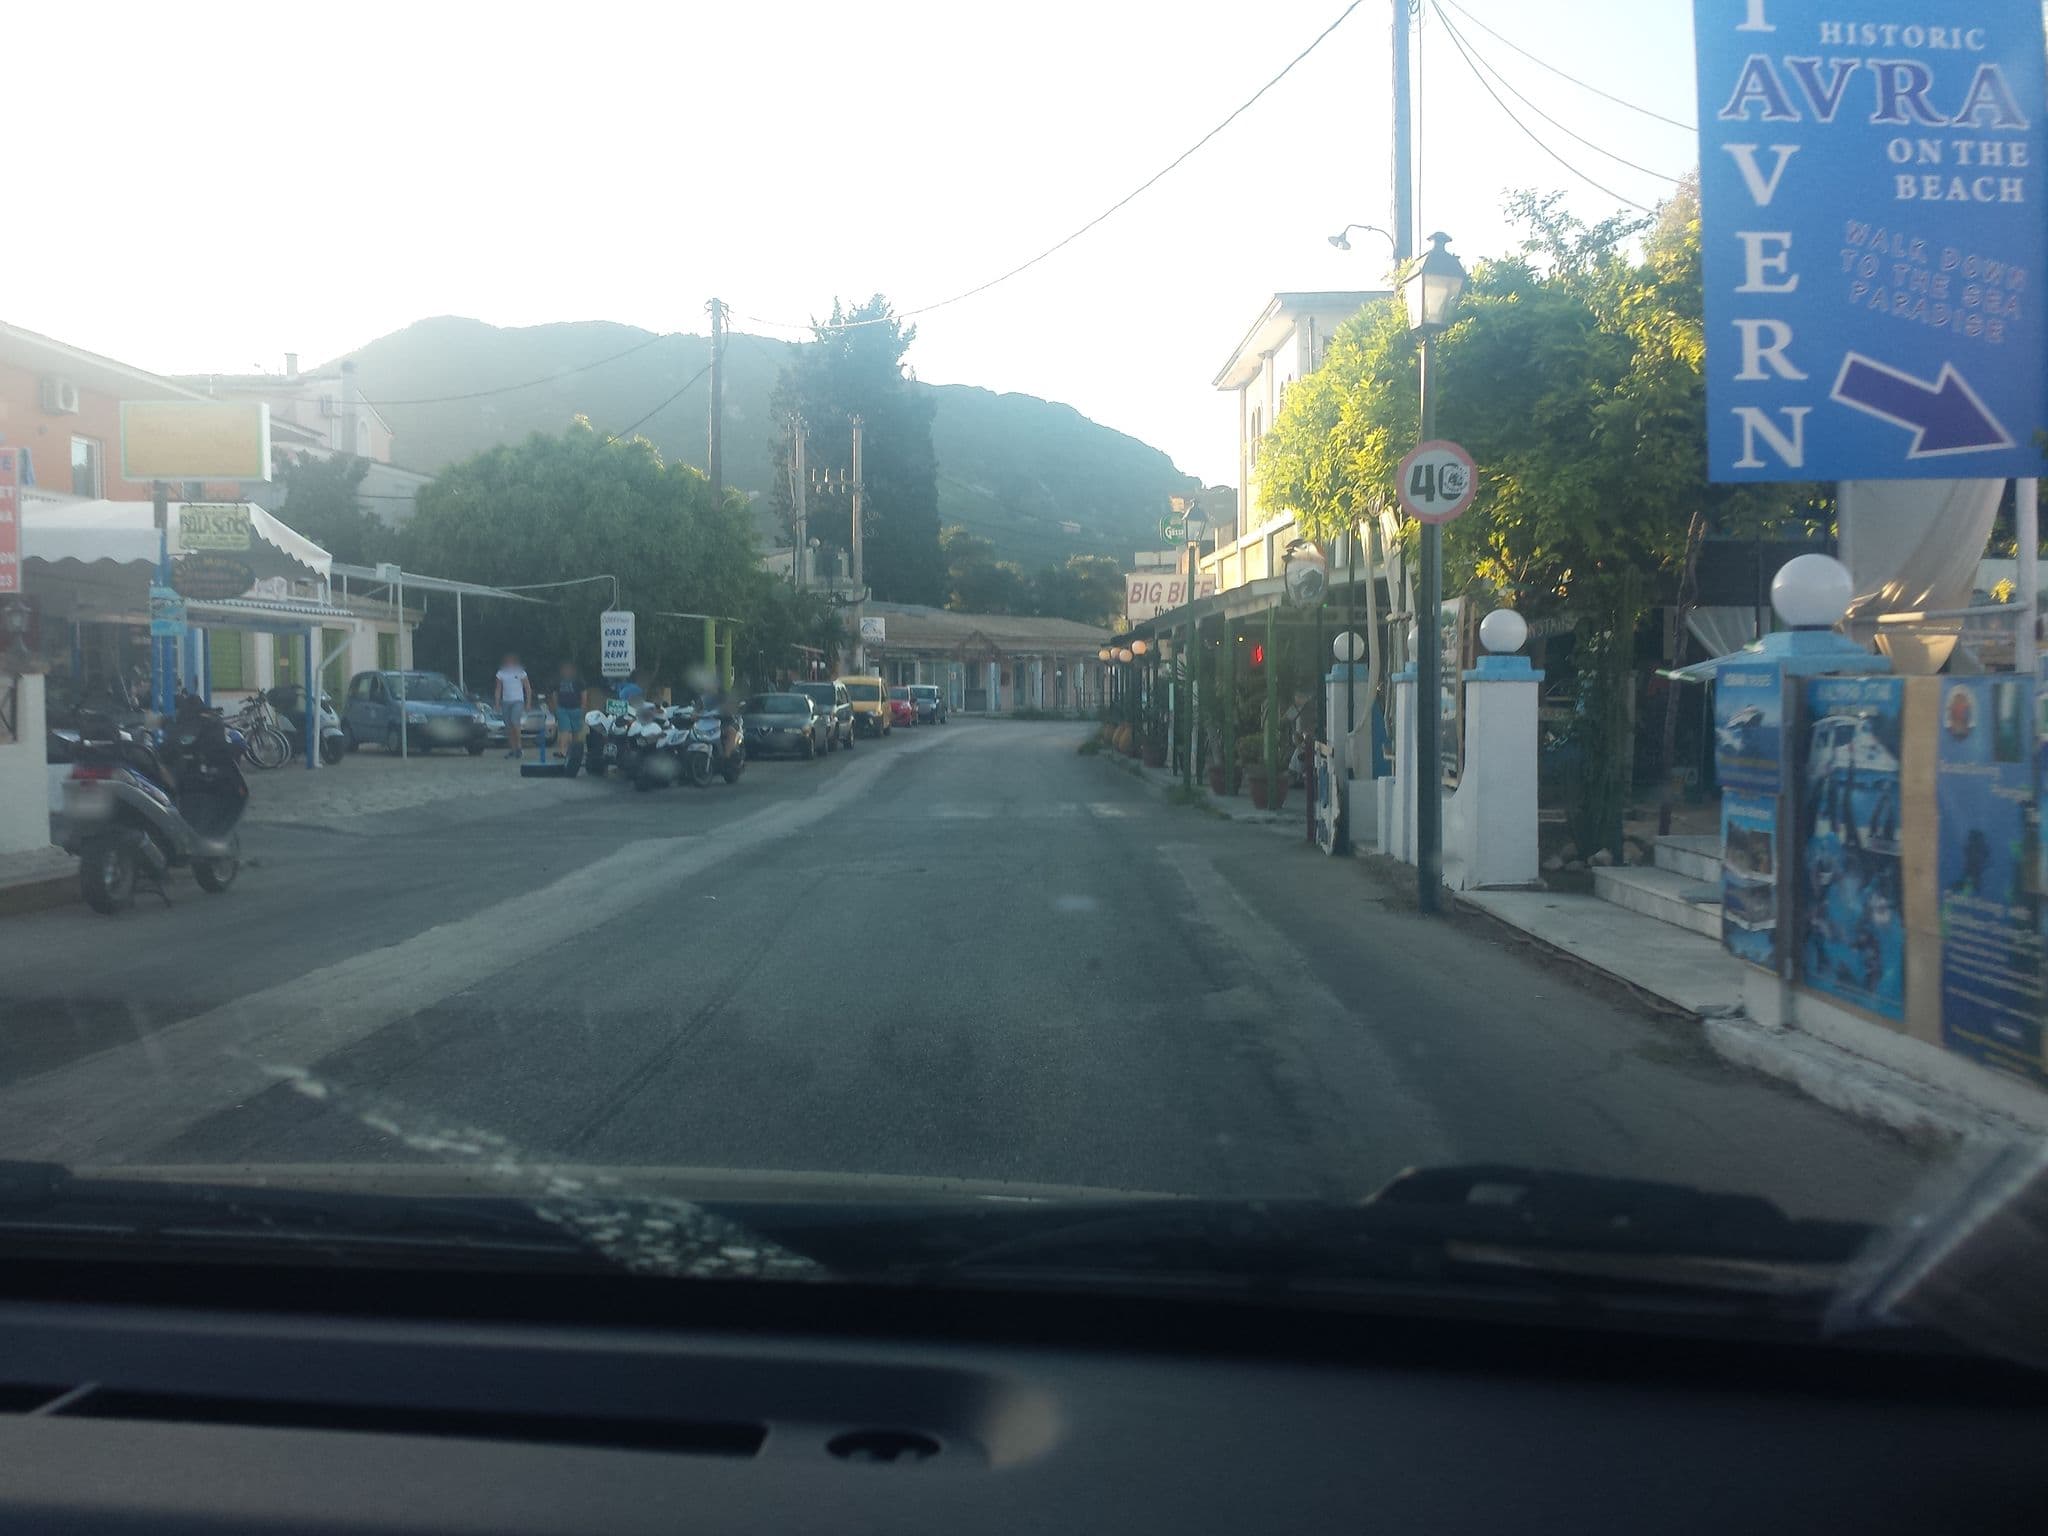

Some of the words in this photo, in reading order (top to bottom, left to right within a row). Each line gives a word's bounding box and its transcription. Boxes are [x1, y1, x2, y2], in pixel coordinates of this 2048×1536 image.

[1819, 22, 1986, 51] HISTORIC
[1717, 54, 2031, 131] AVRA
[1887, 138, 1942, 164] ON
[1951, 140, 2030, 168] THE
[1895, 175, 2026, 204] BEACH
[1845, 218, 1929, 264] WALK
[1940, 246, 2029, 292] DOWN
[1840, 247, 1880, 279] TO
[1891, 262, 1952, 300] THE
[1961, 283, 2022, 320] SEA
[1848, 278, 2006, 345] PARADISE
[1130, 582, 1162, 604] BIG
[1168, 582, 1212, 604] BIE
[604, 627, 627, 637] CARS
[607, 639, 625, 648] FOR
